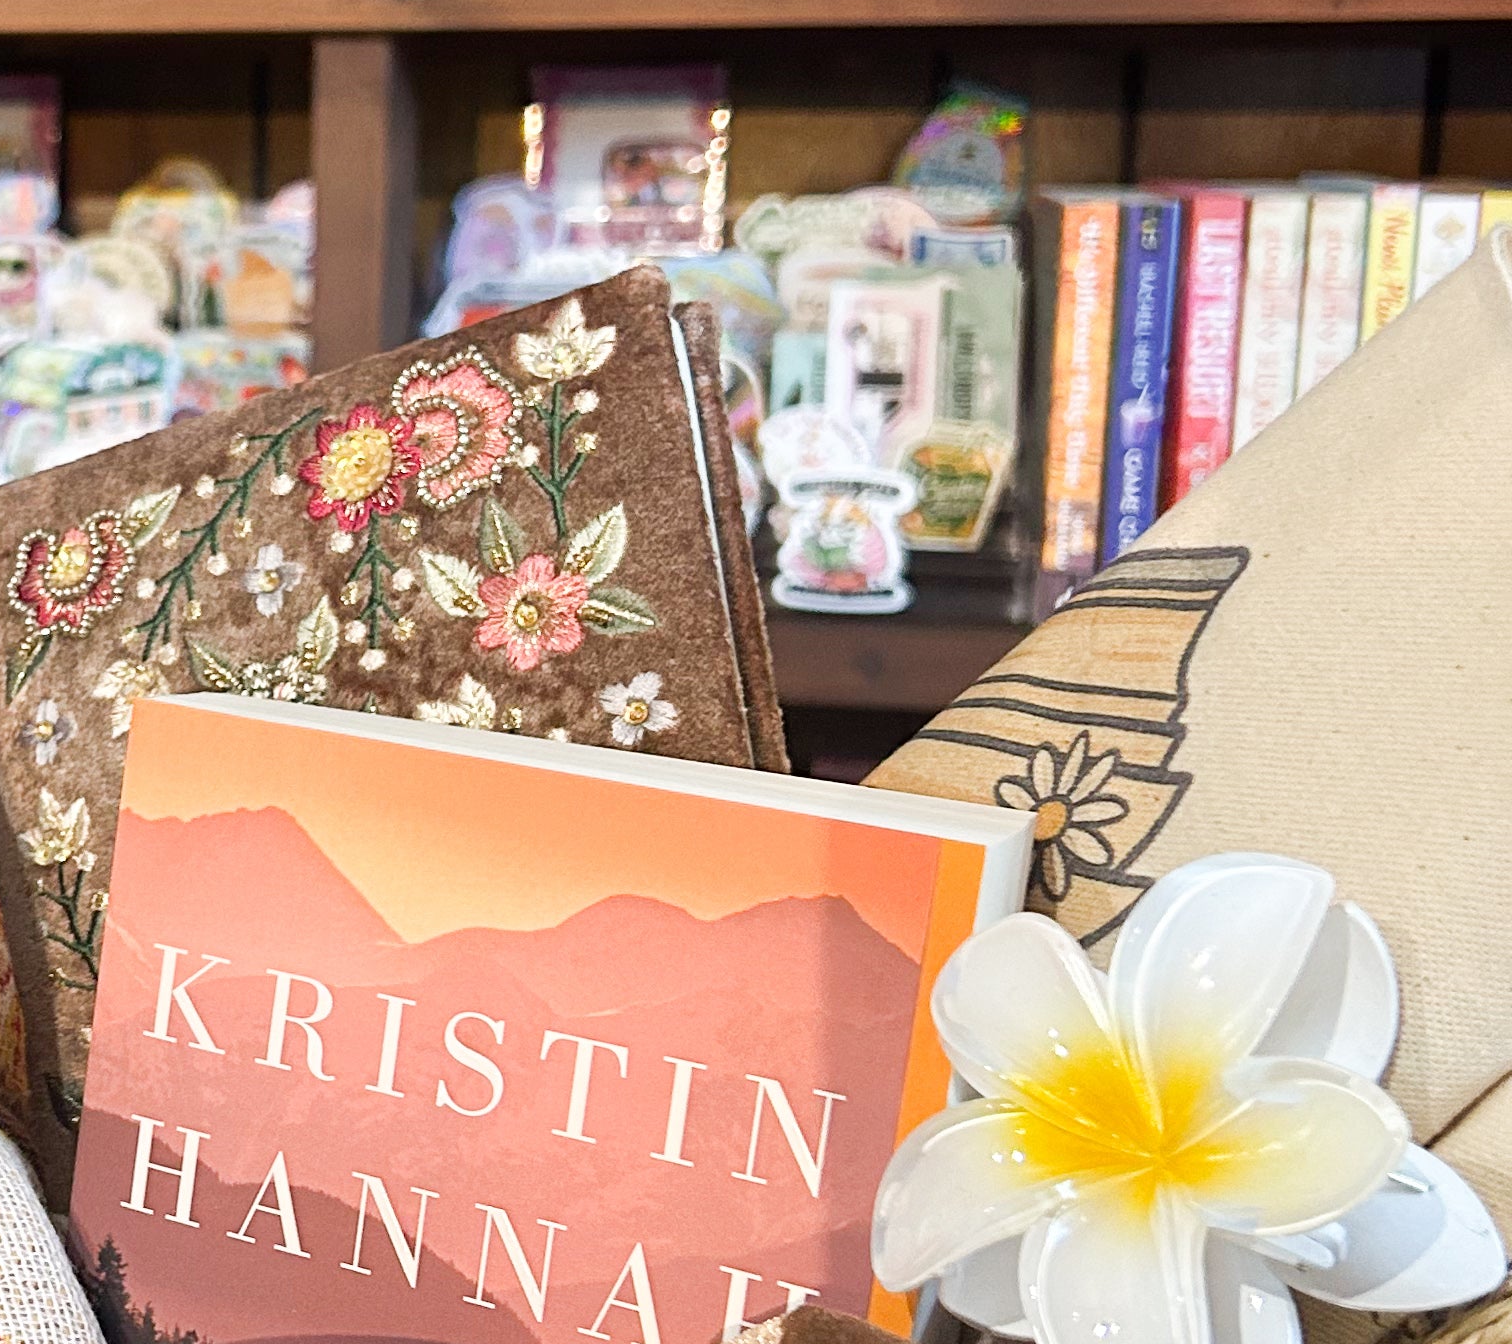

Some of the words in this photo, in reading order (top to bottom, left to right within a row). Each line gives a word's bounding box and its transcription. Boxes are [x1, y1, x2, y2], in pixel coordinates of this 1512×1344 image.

[1193, 217, 1242, 299] LAST
[1186, 301, 1238, 422] RESORT
[142, 943, 847, 1199] KRISTIN
